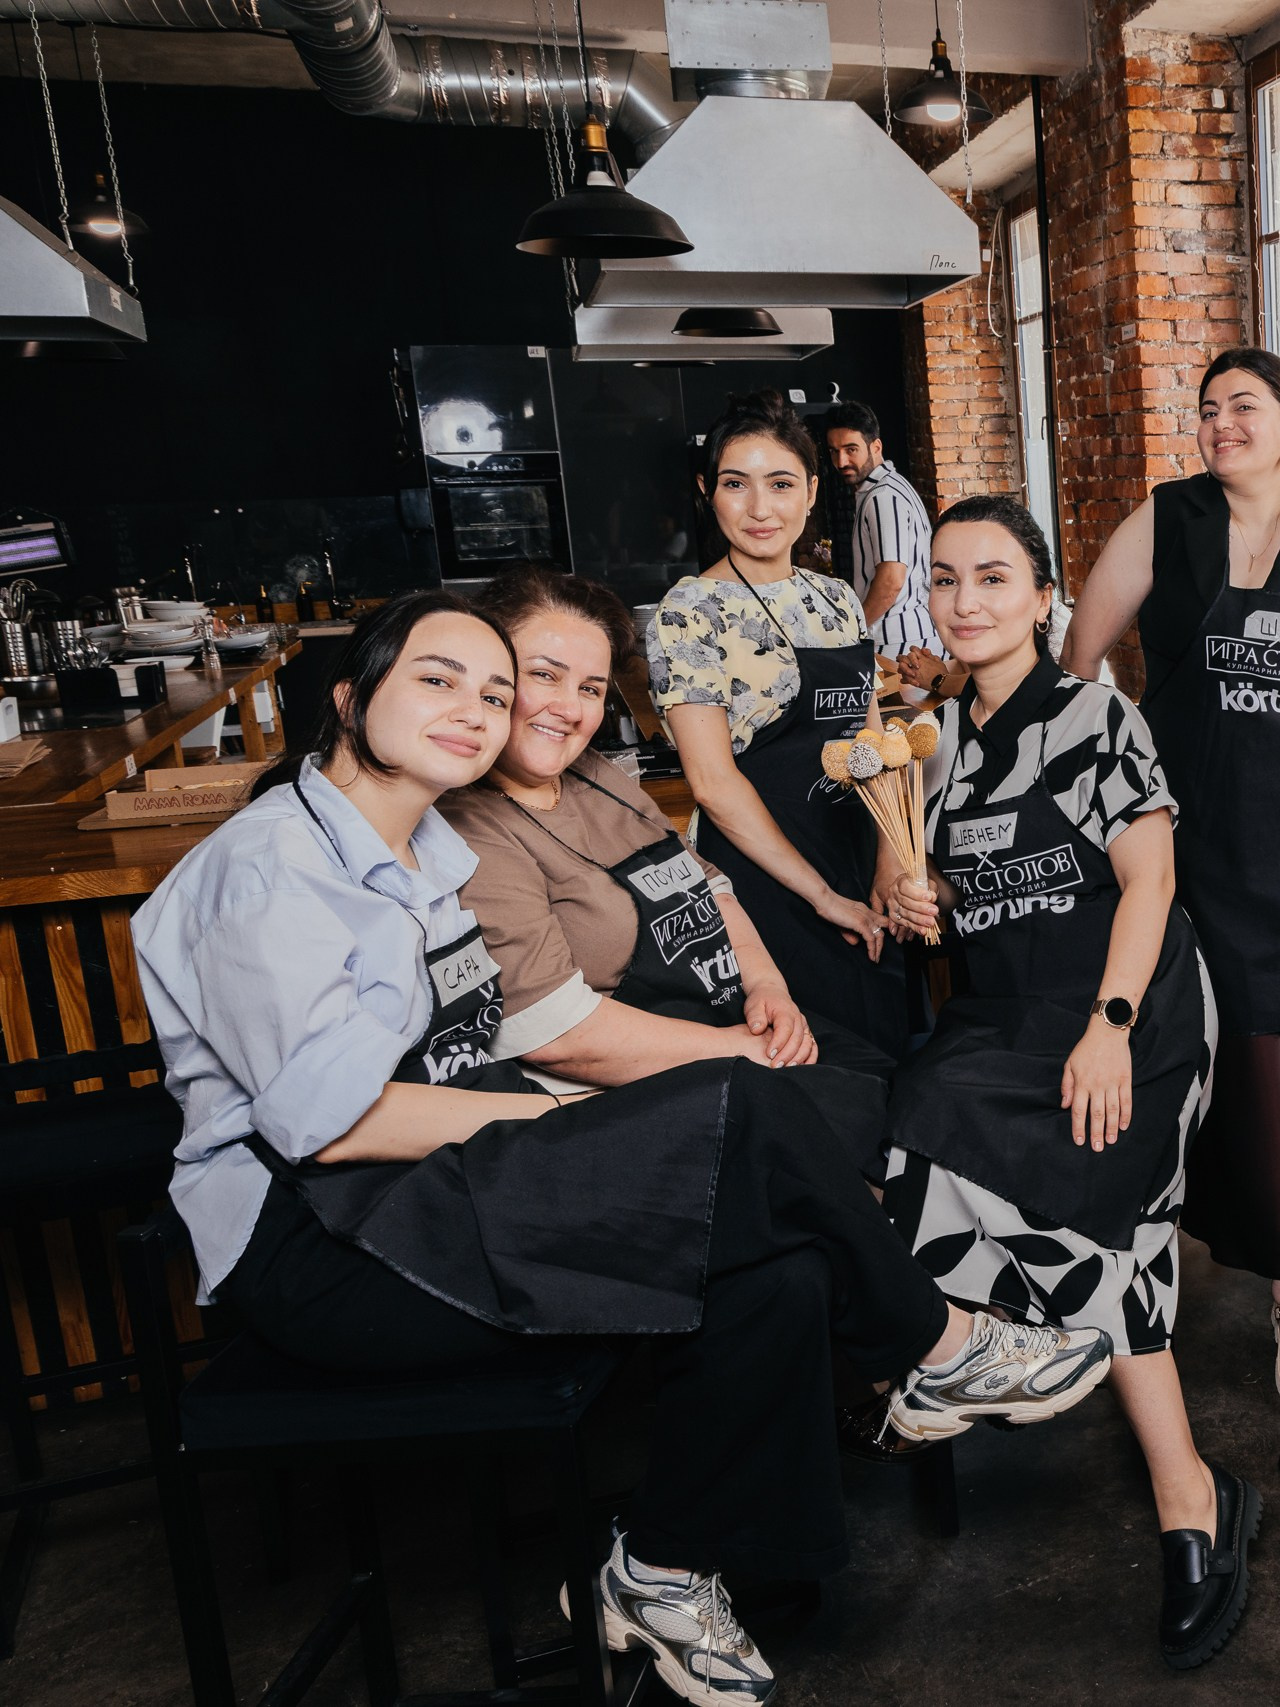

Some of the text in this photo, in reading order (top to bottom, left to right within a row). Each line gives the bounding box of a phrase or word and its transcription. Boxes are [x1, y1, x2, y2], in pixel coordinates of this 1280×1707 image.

[1211, 640, 1259, 665] ИГРА
[819, 691, 859, 709] ИГРА
[134, 793, 228, 812] MAMA ROMA
[952, 823, 1012, 848] ШЕБНЕМ
[975, 851, 1072, 892] СТОЛОВ
[1007, 881, 1048, 896] СТУДИЯ
[655, 910, 695, 948] ИГРА
[443, 954, 482, 990] САРА
